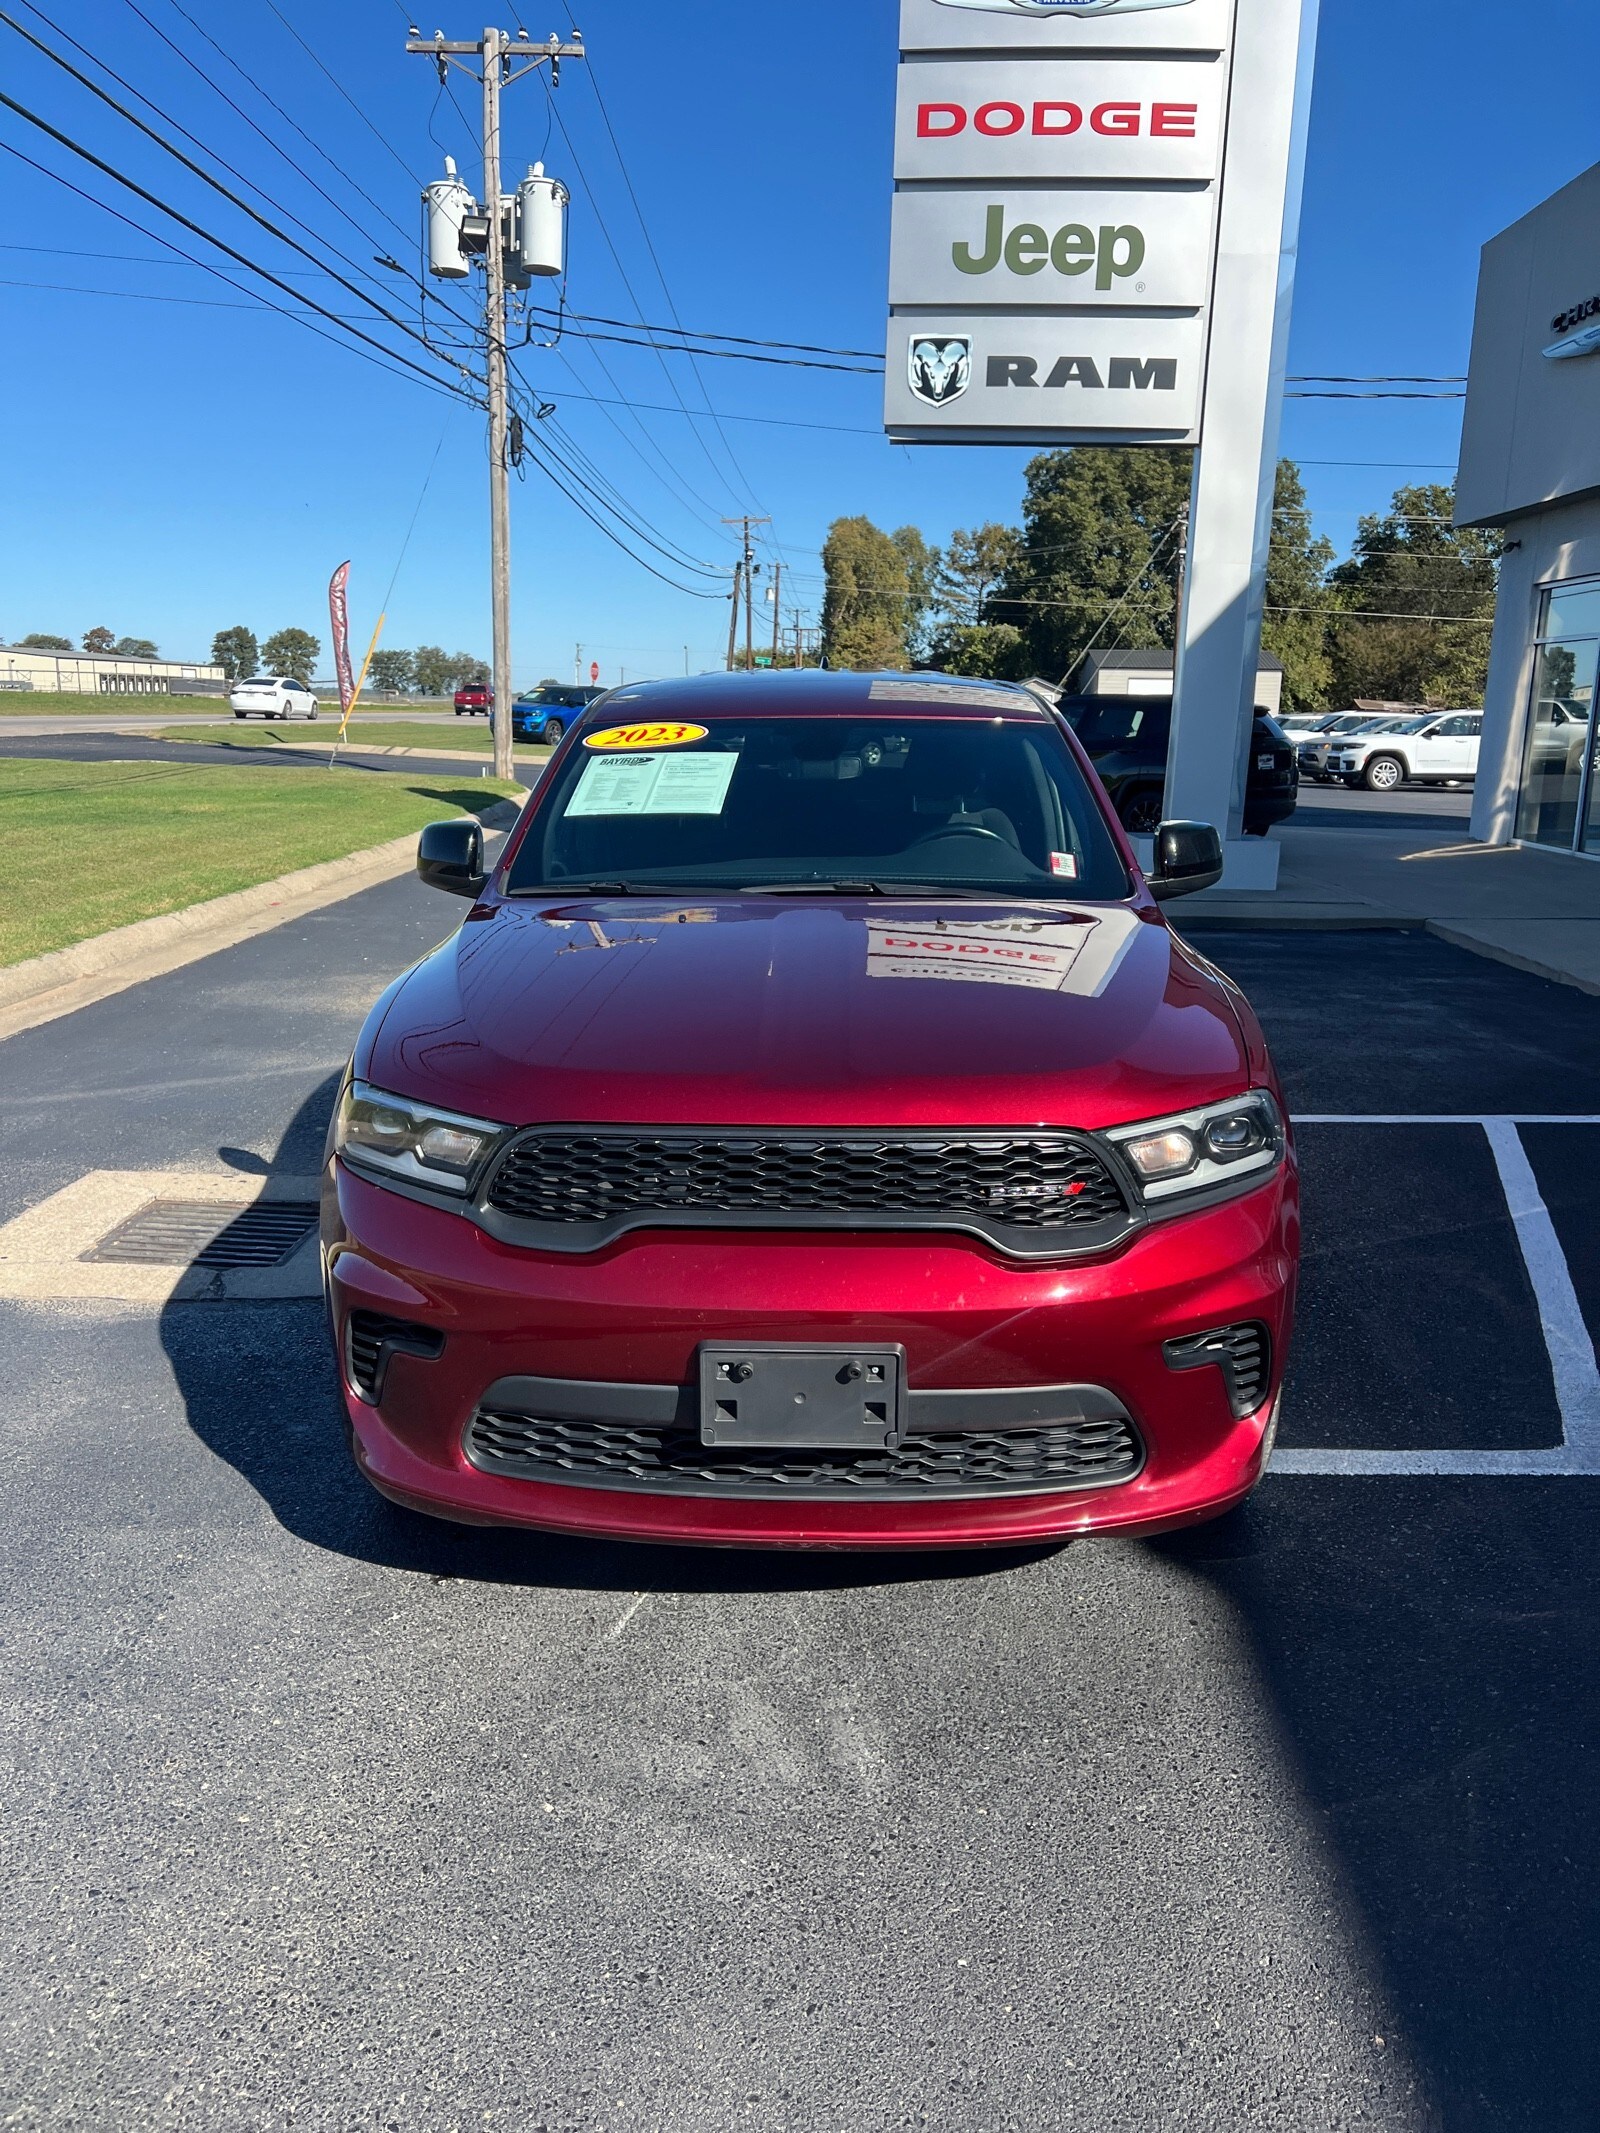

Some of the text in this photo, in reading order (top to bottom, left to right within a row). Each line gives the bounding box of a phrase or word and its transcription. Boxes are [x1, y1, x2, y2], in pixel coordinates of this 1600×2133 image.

[916, 101, 1198, 138] DODGE
[952, 205, 1145, 291] Jeep
[985, 355, 1177, 390] RAM
[603, 726, 688, 745] 2023
